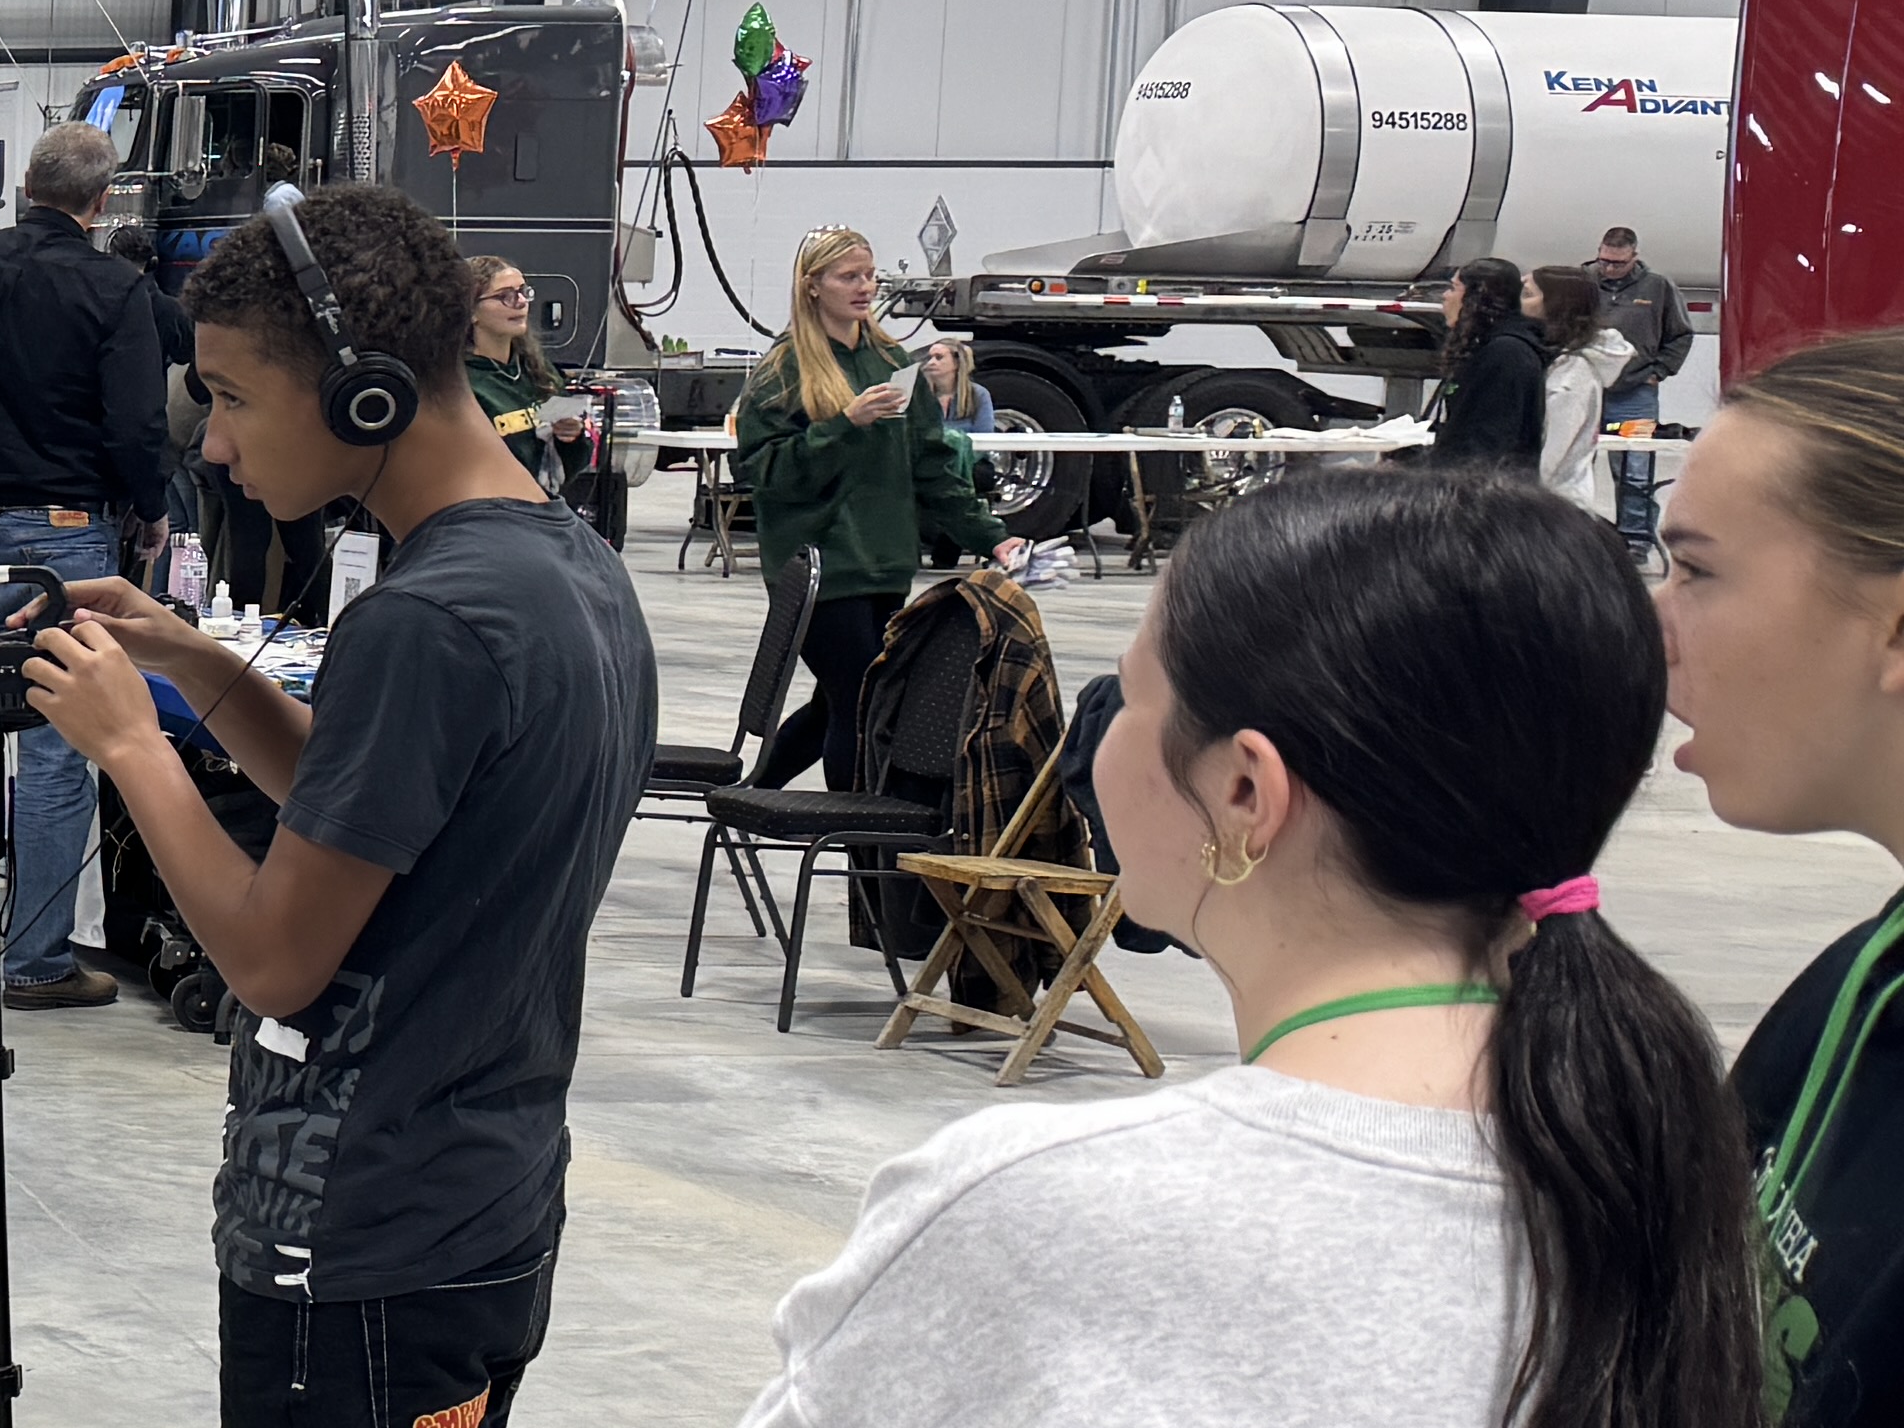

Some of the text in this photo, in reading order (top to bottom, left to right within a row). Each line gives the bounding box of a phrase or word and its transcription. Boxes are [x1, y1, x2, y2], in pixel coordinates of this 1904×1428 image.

[1135, 80, 1191, 101] 94515288
[1543, 70, 1658, 93] KENAN
[1371, 110, 1468, 131] 94515288
